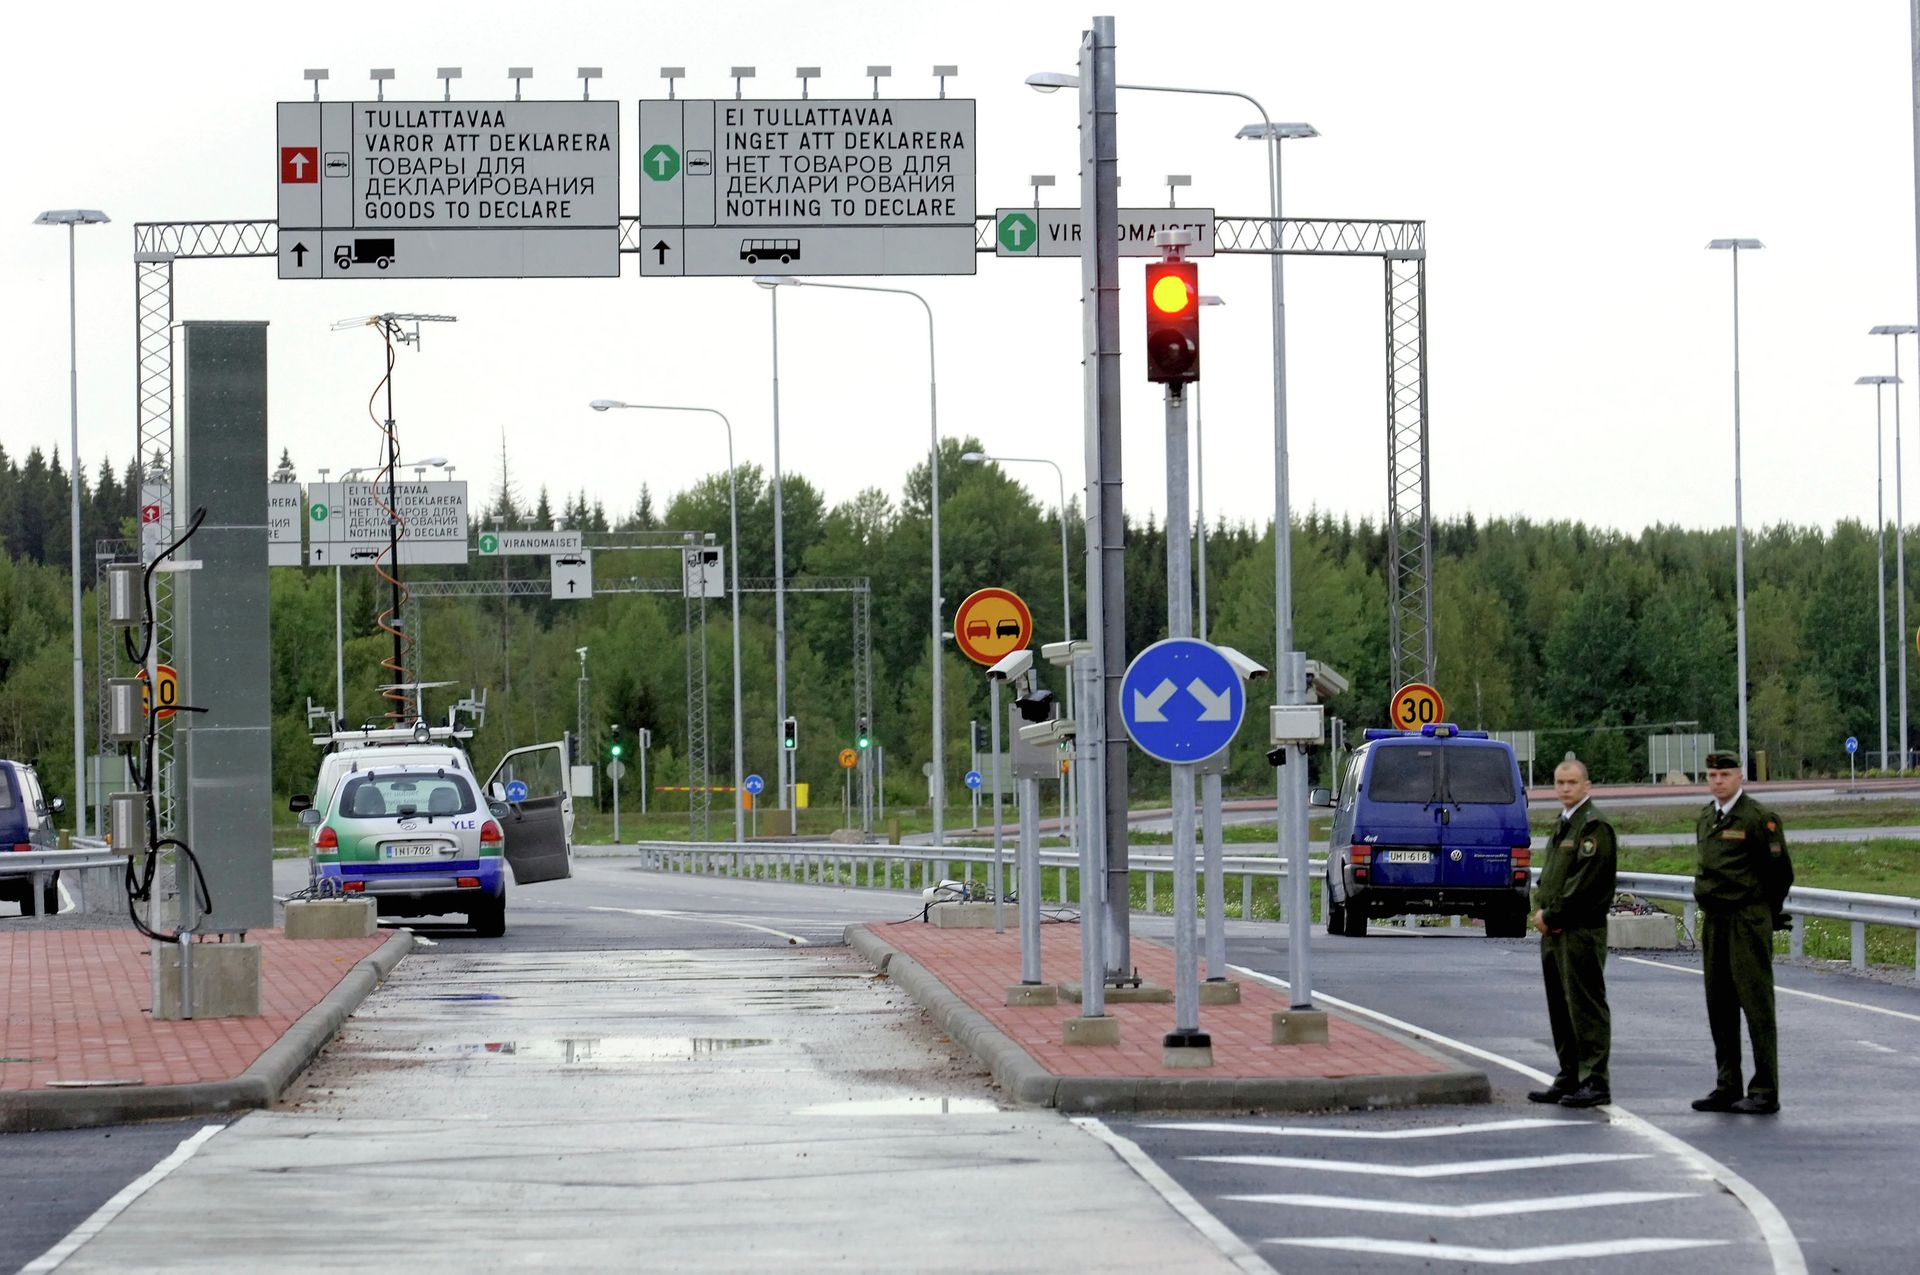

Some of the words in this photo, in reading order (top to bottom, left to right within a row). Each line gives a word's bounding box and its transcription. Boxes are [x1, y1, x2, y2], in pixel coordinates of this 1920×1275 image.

[365, 110, 505, 128] TULLATTAVAA
[727, 109, 743, 126] EI
[754, 108, 893, 126] TULLATTAVAA
[366, 134, 433, 152] VAROR
[444, 134, 480, 152] ATT
[490, 134, 610, 151] DEKLARERA
[727, 132, 788, 150] INGET
[800, 132, 835, 149] ATT
[845, 132, 964, 149] DEKLARERA
[366, 157, 465, 175] ТОВАРЫ
[476, 157, 524, 178] ДЛЯ
[727, 156, 769, 173] НЕТ
[780, 155, 892, 173] ТОВАРОВ
[903, 156, 951, 176] ДЛЯ
[366, 178, 594, 199] ДЕКЛАРИРОВАНИЯ
[366, 201, 434, 219] GOODS
[445, 201, 469, 218] TO
[480, 201, 571, 218] DECLARE
[727, 199, 820, 216] NOTHING
[831, 199, 854, 216] TO
[865, 199, 955, 216] DECLARE
[349, 487, 358, 495] EI
[384, 497, 401, 506] AT
[405, 496, 462, 505] DEKLARERA
[349, 509, 370, 517] НЕТ
[376, 508, 428, 517] ТОАРОВ
[433, 507, 456, 518] ДЛЯ
[414, 528, 459, 537] DECLARE
[503, 538, 577, 547] VIRANOMAISET
[1402, 698, 1433, 723] 30
[452, 820, 475, 830] YLE
